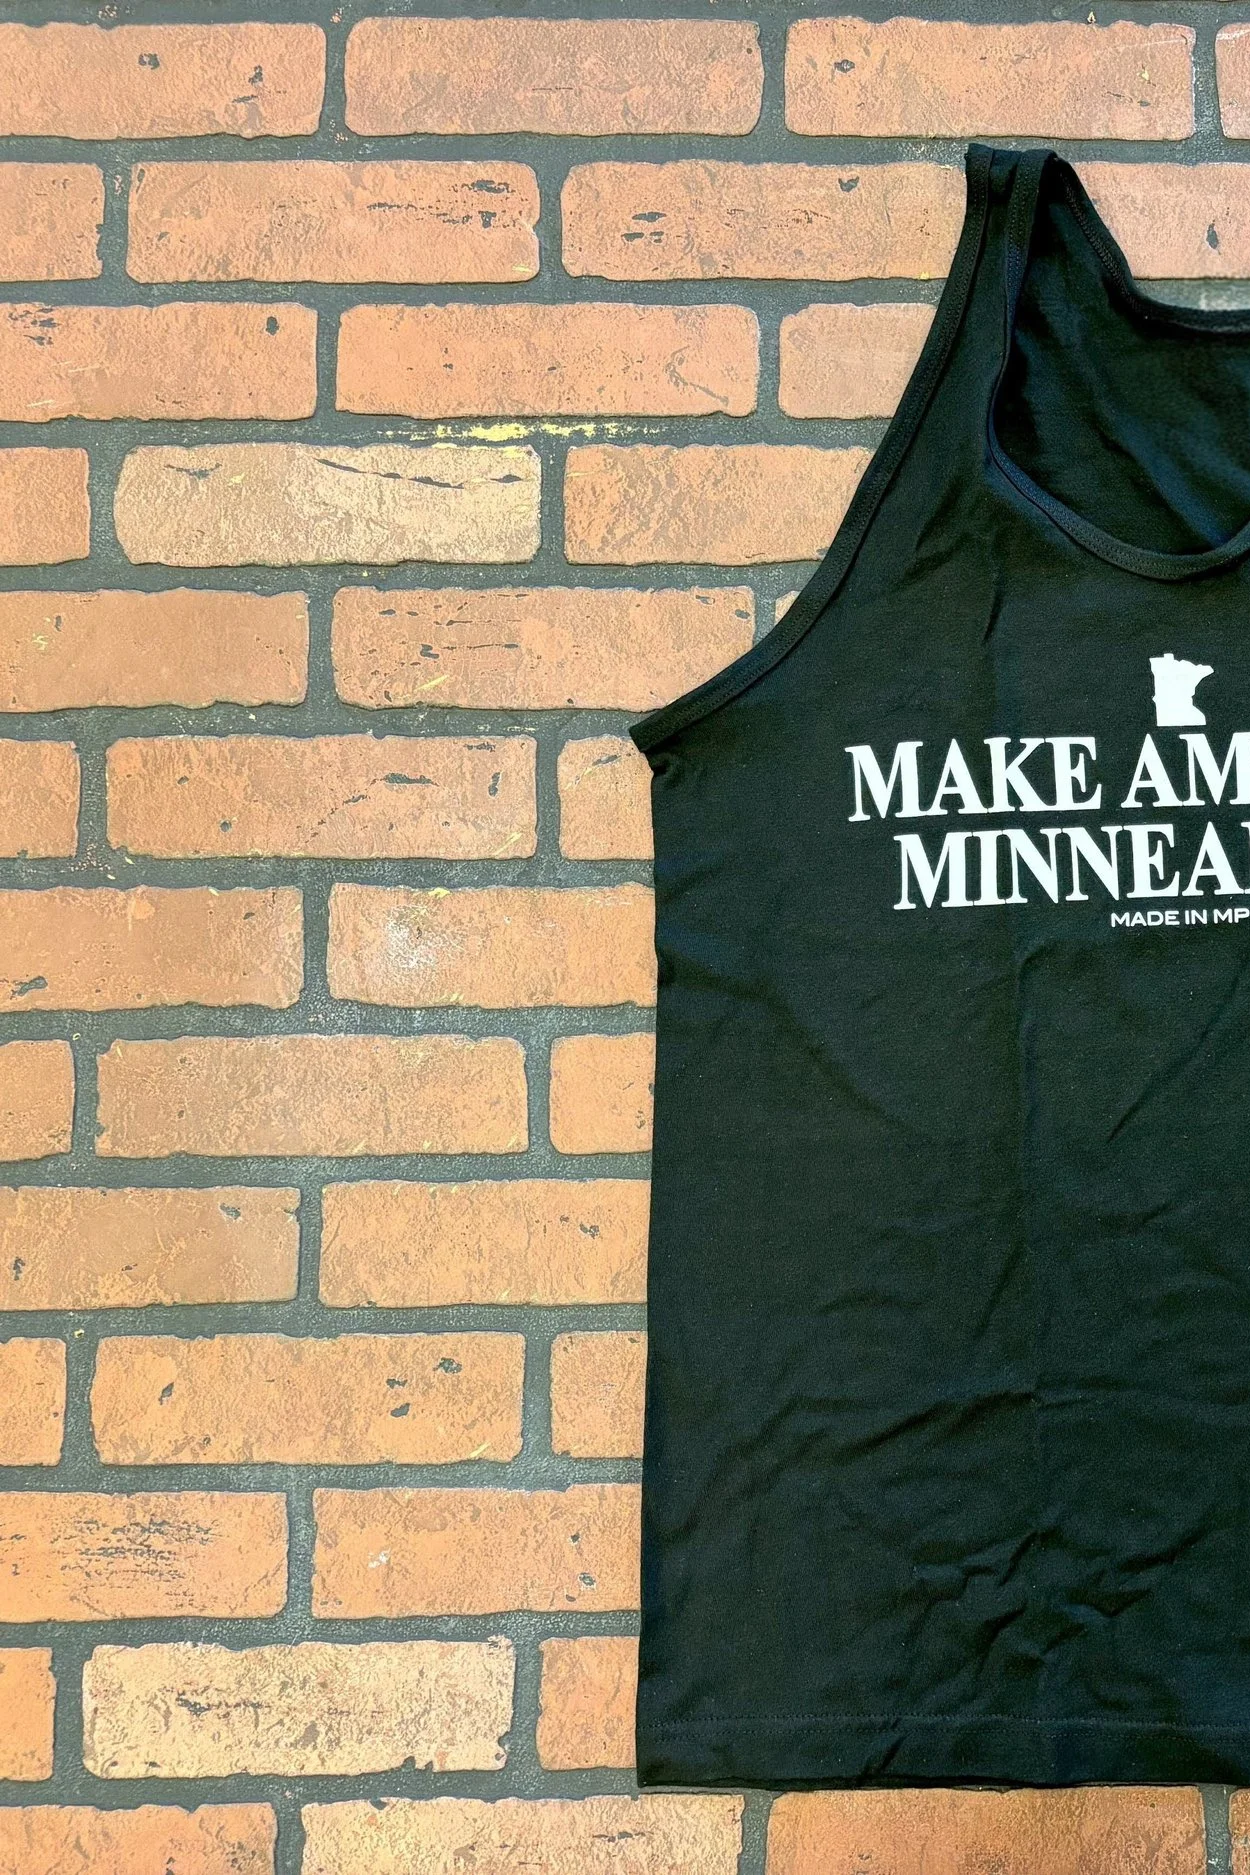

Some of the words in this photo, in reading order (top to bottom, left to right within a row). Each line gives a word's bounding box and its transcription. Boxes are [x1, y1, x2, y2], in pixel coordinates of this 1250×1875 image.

[845, 737, 1102, 822] MAKE
[1111, 910, 1180, 928] MADE
[1184, 909, 1208, 925] IN
